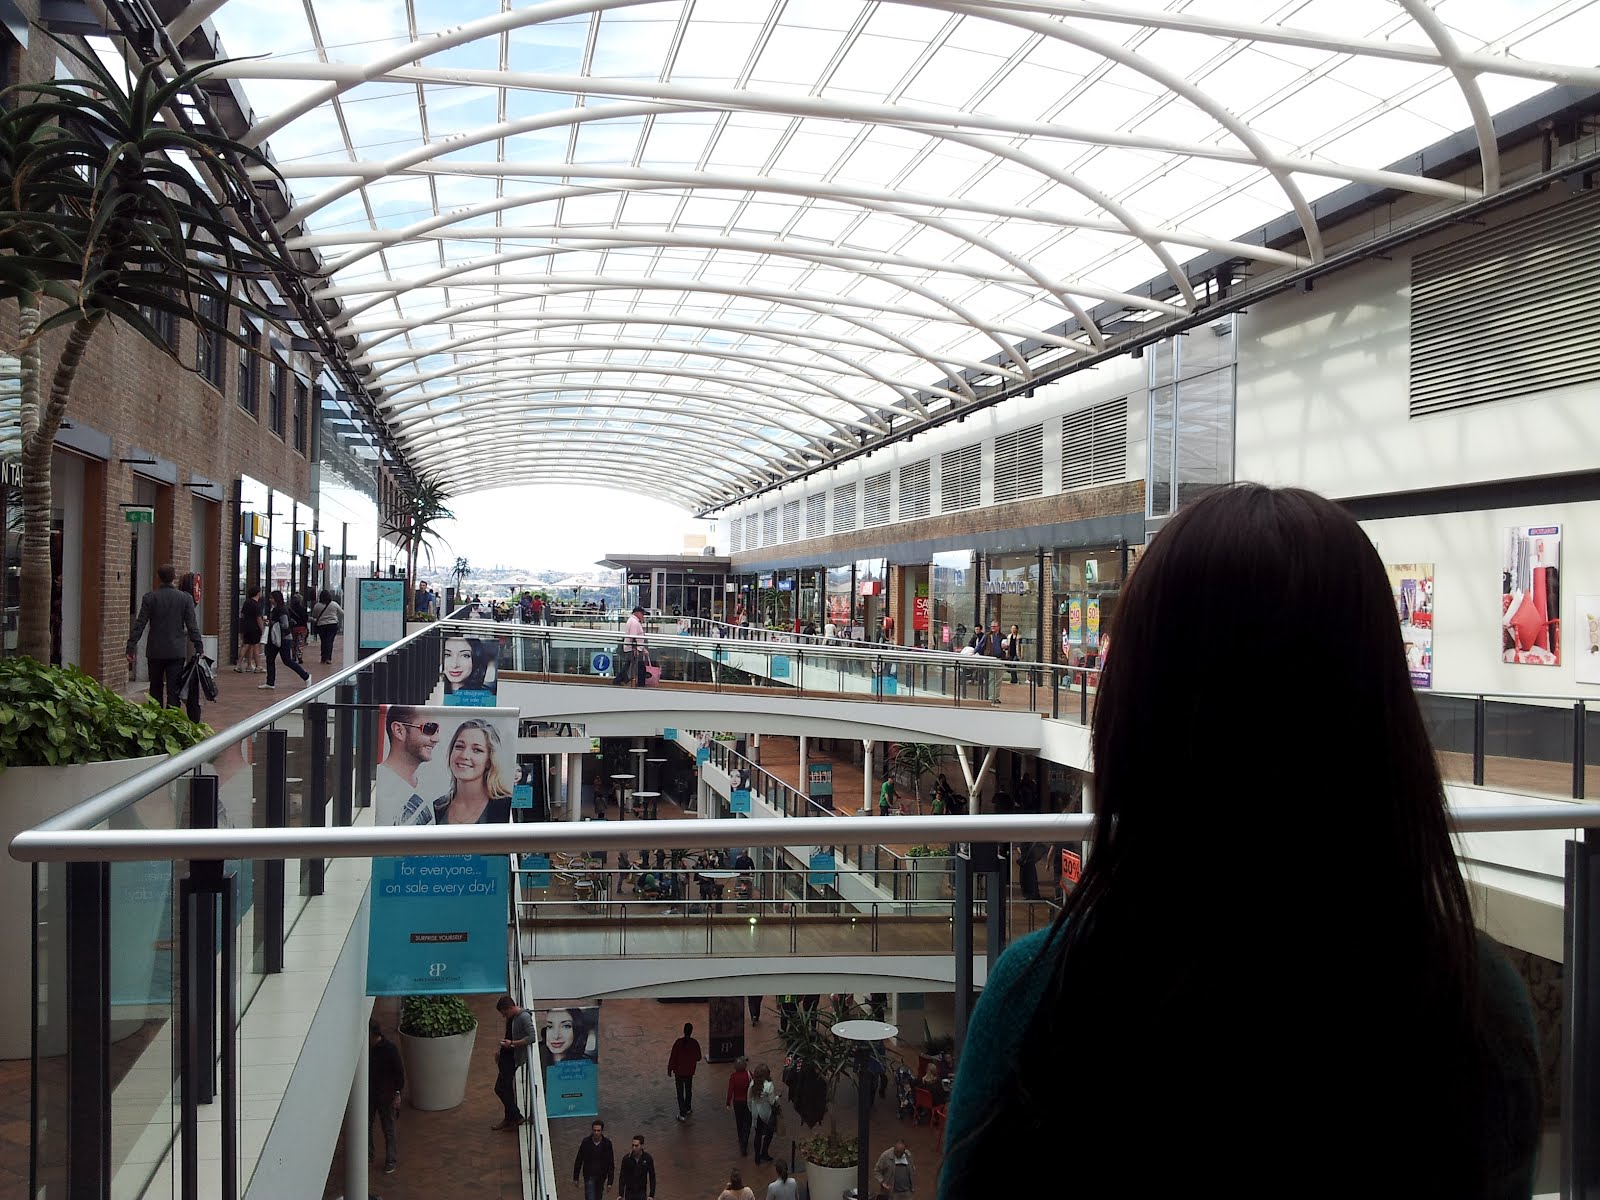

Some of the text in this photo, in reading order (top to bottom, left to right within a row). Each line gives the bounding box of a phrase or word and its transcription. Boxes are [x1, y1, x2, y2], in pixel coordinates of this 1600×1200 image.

[401, 862, 482, 878] for everyone...
[385, 879, 495, 896] on sale every day!
